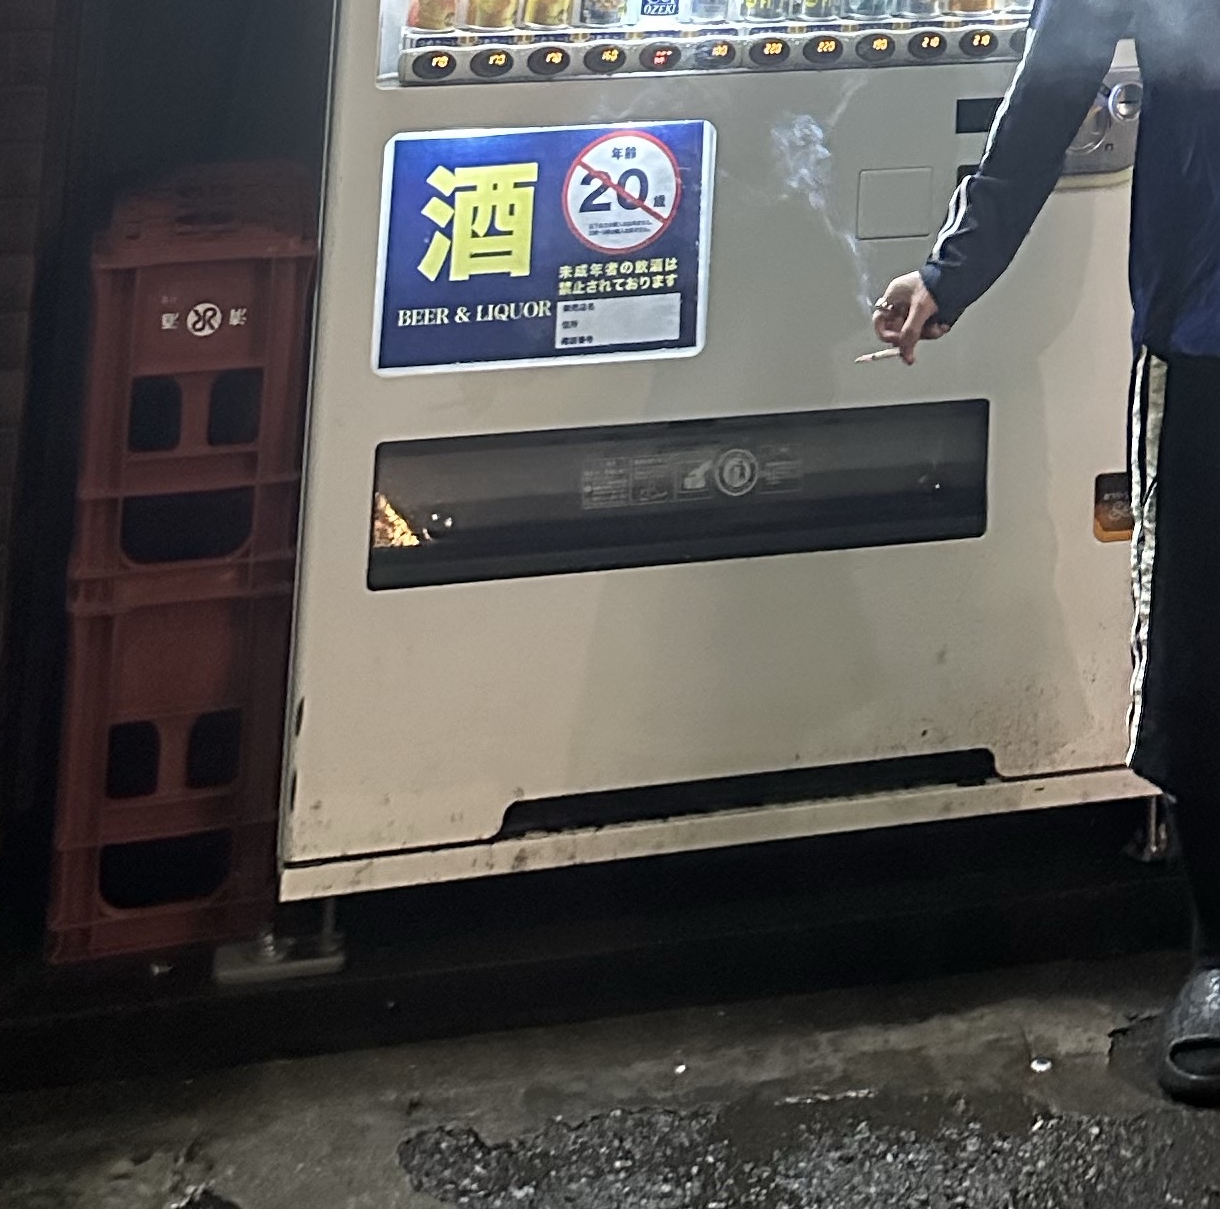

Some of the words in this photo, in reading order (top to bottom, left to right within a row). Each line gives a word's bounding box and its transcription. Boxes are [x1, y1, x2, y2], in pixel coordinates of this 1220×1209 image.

[643, 4, 677, 15] OZEKI
[578, 167, 649, 214] 20
[417, 162, 539, 282] 酒
[558, 273, 679, 296] 禁止されております
[398, 307, 450, 327] BEER
[454, 304, 470, 324] &
[476, 299, 552, 323] LIQUOR
